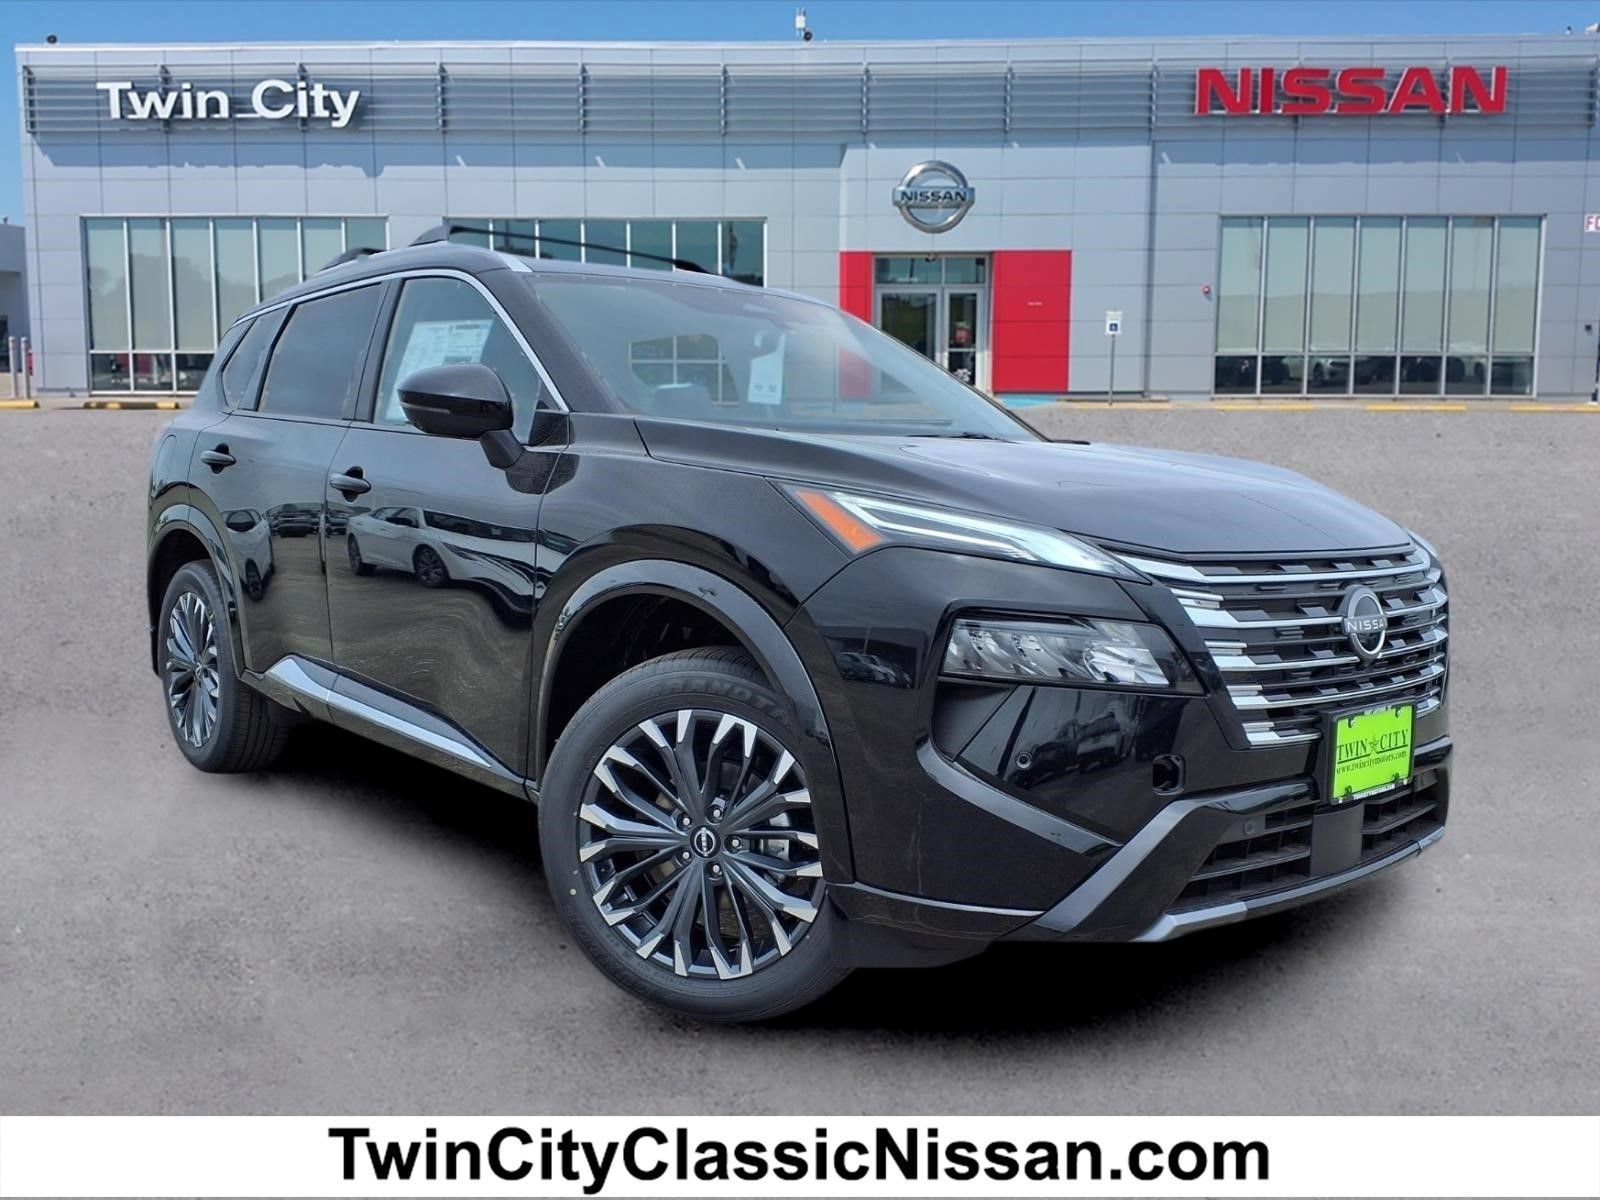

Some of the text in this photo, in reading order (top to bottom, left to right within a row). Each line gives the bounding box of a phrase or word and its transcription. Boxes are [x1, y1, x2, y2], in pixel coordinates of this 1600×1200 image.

[96, 79, 361, 129] Twin City
[1195, 66, 1509, 115] NISSAN
[901, 191, 967, 203] NISSAN
[1336, 729, 1409, 761] TWIN CITY
